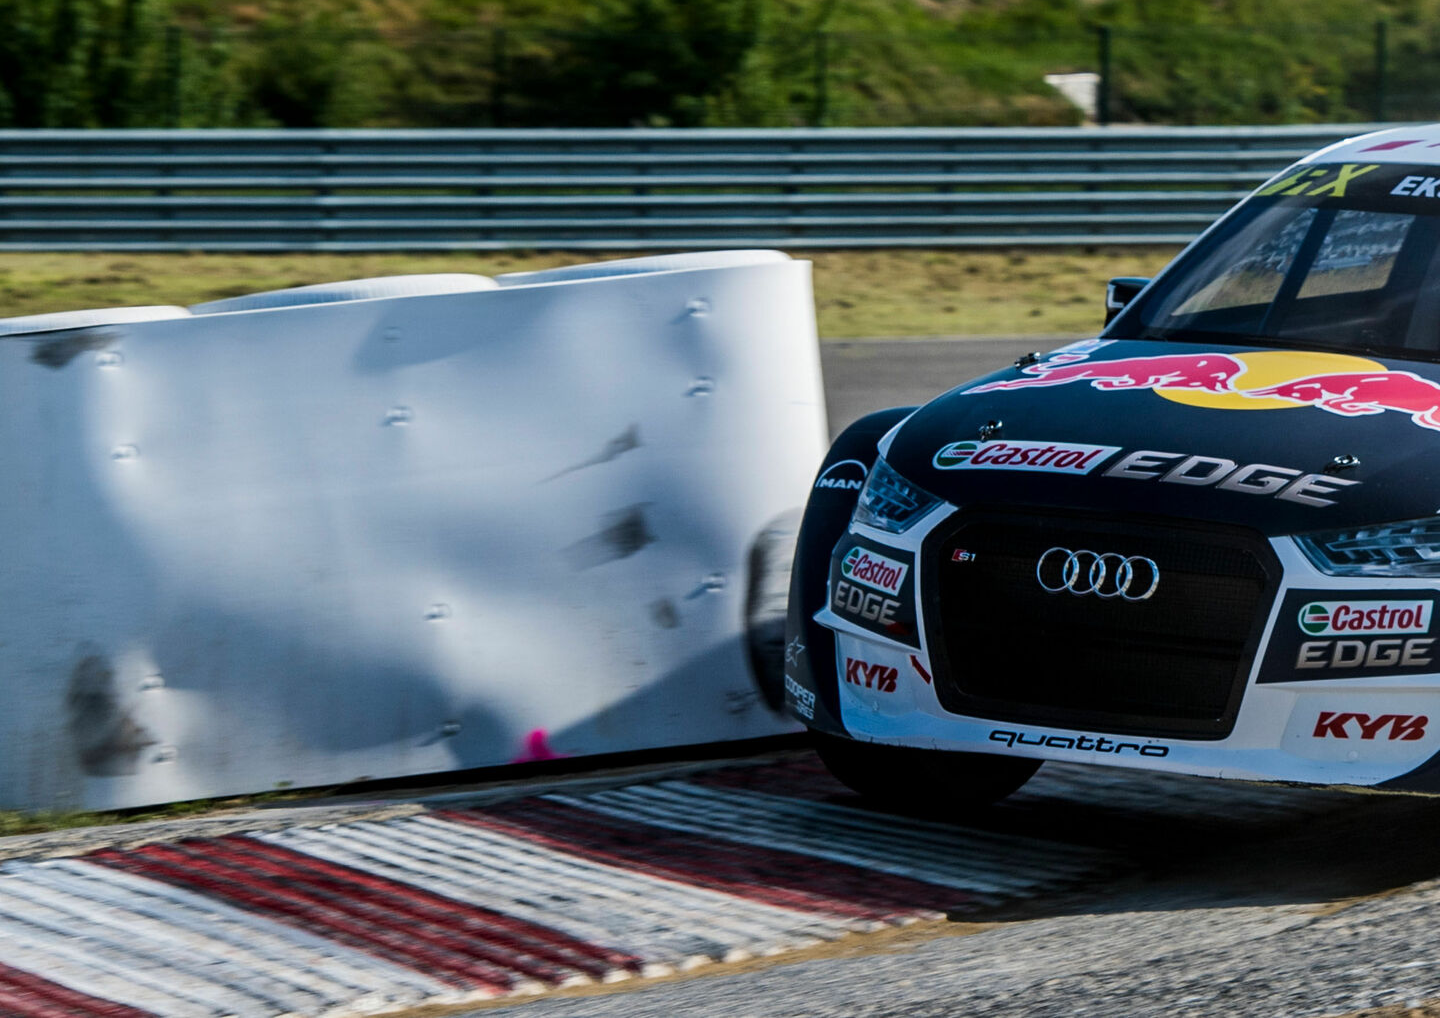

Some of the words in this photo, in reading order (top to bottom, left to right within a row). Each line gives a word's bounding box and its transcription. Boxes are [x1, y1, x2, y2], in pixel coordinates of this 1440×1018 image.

[820, 478, 862, 490] MAN
[971, 443, 1104, 471] Castrol
[1101, 450, 1362, 508] EDGE
[852, 553, 903, 591] Castrol
[834, 580, 901, 626] EDGE
[1331, 604, 1424, 631] Castrol
[1295, 638, 1437, 669] EDGE
[846, 657, 898, 693] KYB
[1312, 711, 1429, 741] KYB
